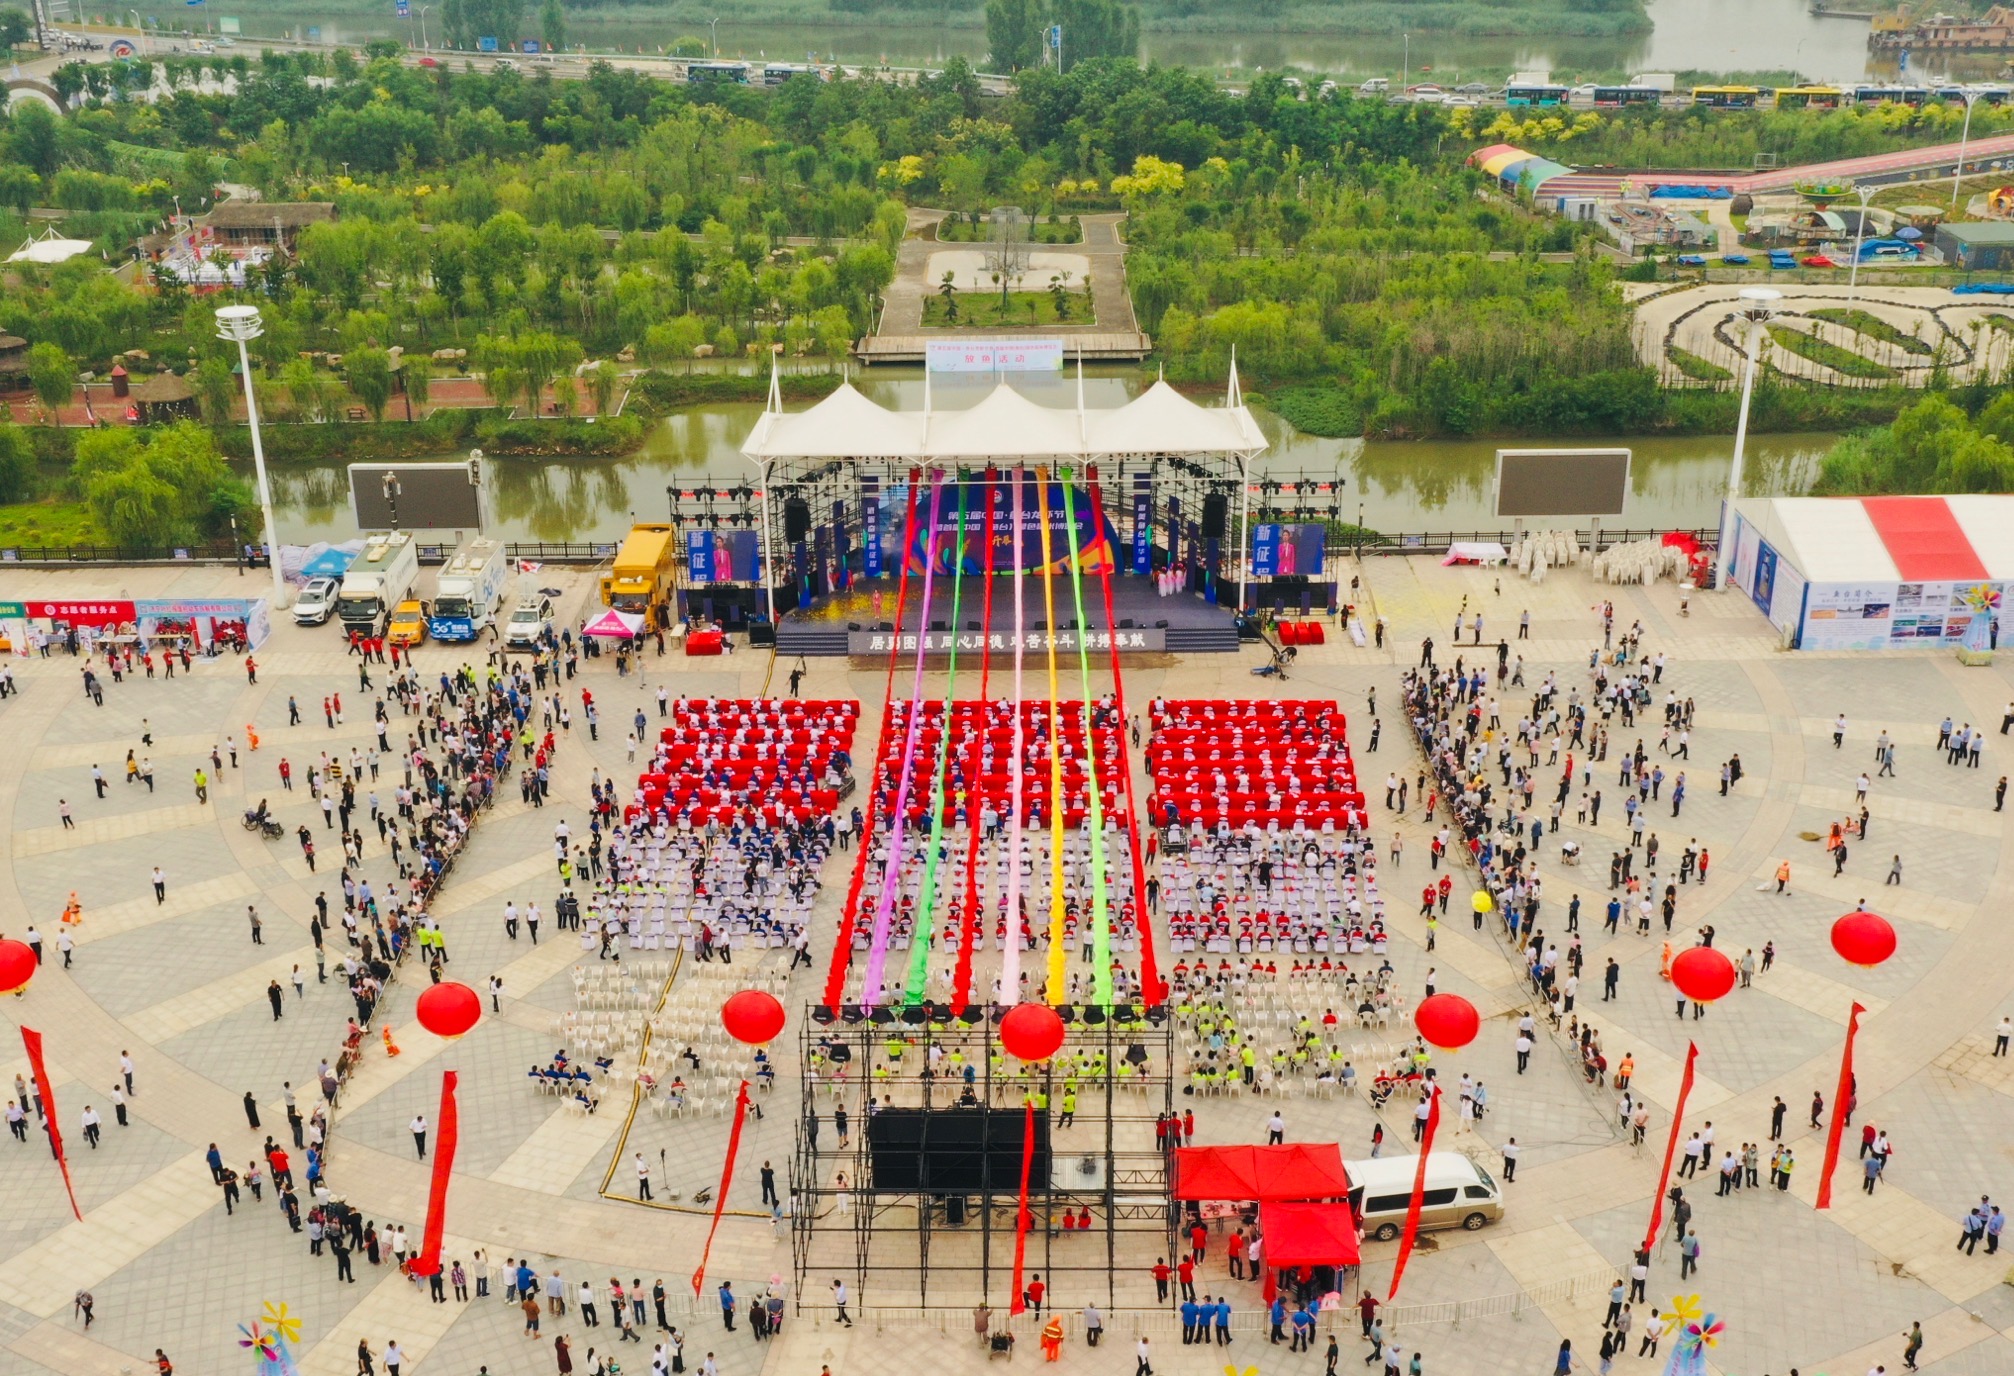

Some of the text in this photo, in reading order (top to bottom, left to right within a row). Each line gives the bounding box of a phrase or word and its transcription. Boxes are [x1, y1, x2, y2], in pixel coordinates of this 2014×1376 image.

[992, 534, 1024, 547] 开幕
[60, 605, 118, 615] 志愿者服务点
